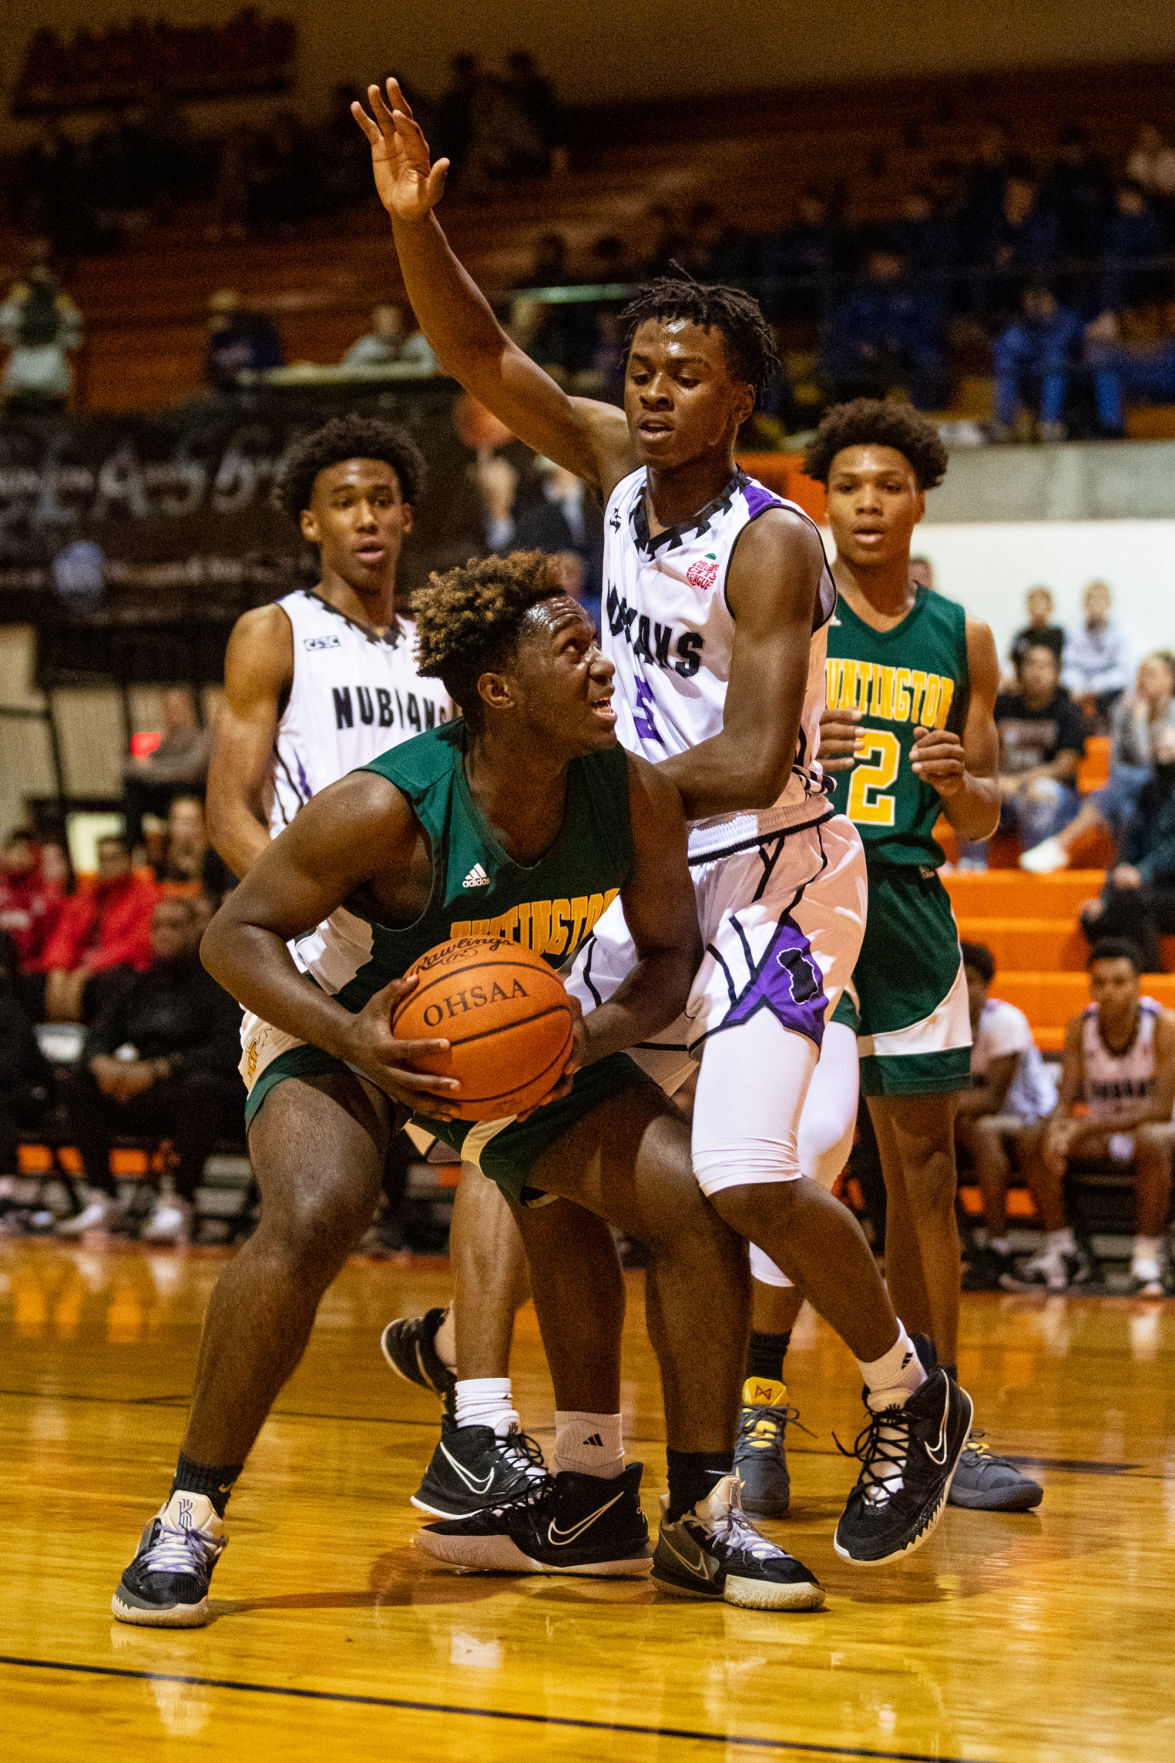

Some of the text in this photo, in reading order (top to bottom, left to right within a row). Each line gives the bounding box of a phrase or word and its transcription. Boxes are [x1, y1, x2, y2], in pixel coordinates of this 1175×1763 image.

[825, 657, 955, 731] UNTINGTON
[845, 728, 901, 827] 2
[462, 877, 491, 889] adidas
[409, 937, 515, 976] Rawlings
[423, 978, 530, 1027] OHSAA
